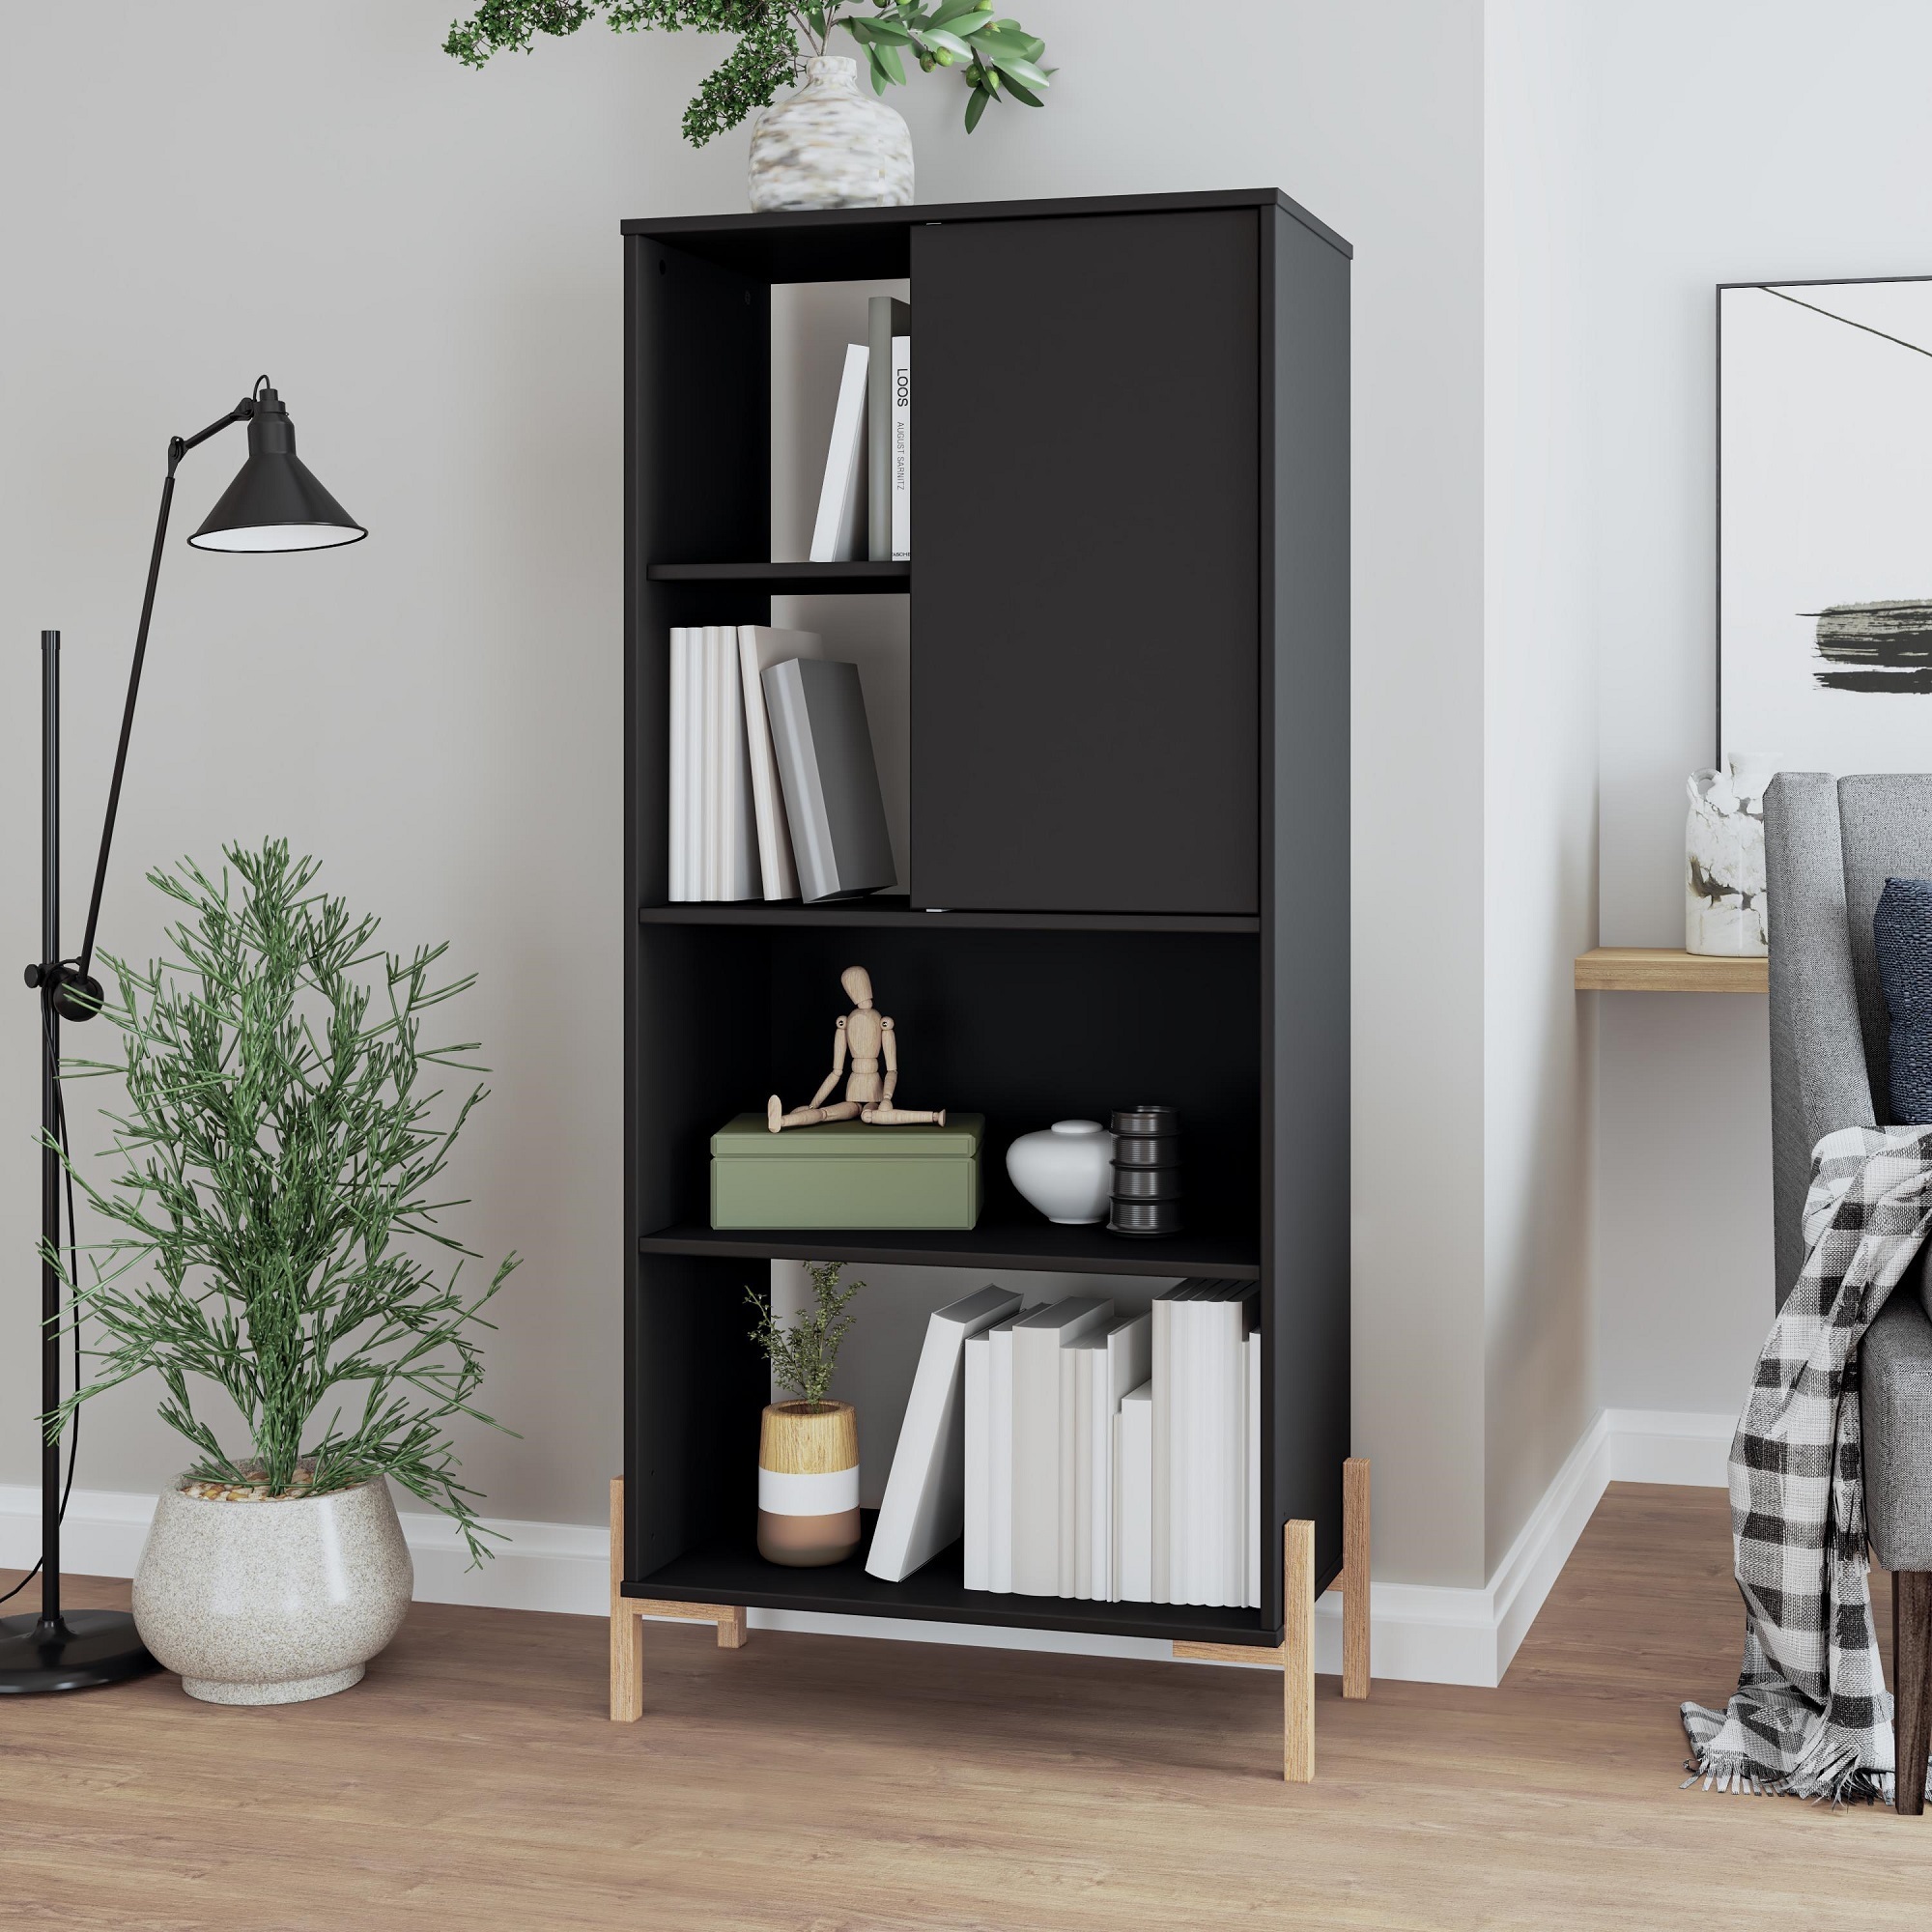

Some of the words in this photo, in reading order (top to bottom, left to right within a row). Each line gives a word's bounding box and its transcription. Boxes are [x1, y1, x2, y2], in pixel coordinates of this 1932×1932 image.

[896, 368, 908, 407] LOOS
[896, 421, 905, 454] AUGUST
[896, 456, 905, 490] SARNITZ
